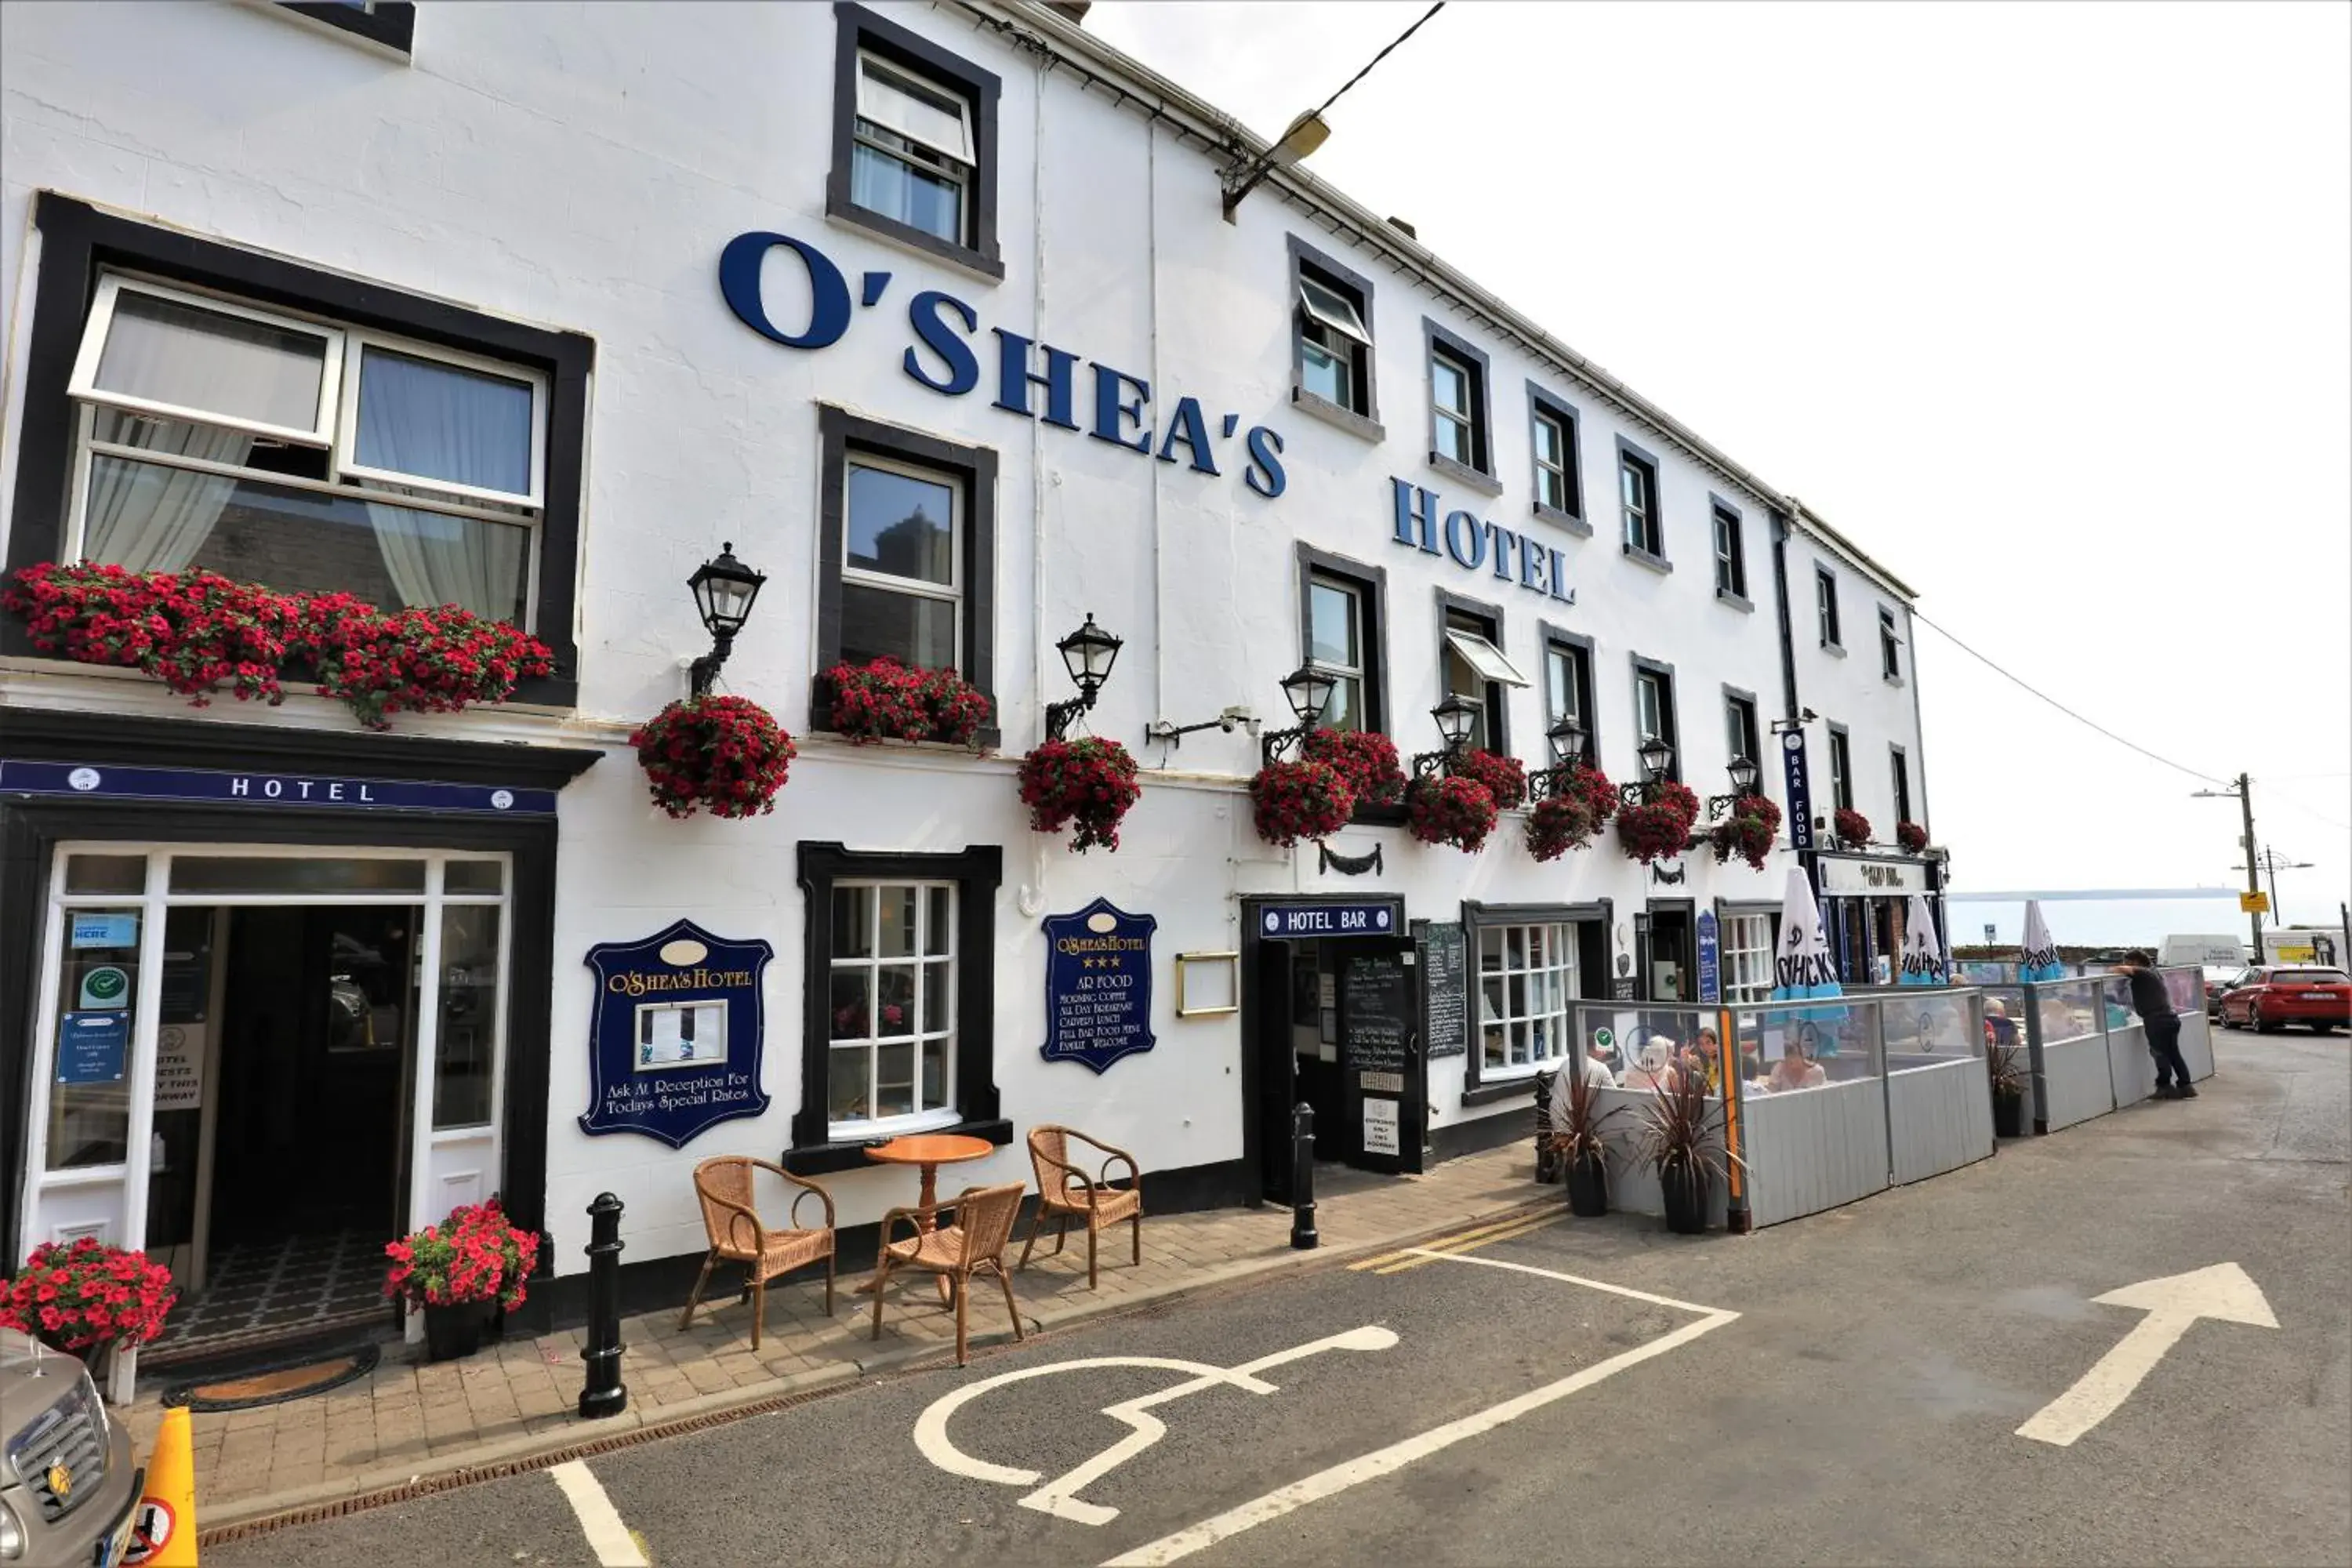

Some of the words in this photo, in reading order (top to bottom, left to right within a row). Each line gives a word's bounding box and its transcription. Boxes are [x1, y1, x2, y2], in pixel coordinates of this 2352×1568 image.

[719, 231, 1287, 498] O'SHEA'S
[1389, 475, 1576, 605] HOTEL
[1791, 755, 1802, 788] BAR
[231, 778, 375, 801] HOTEL
[1795, 800, 1807, 846] FOOD
[1288, 912, 1333, 931] HOTEL
[1341, 910, 1367, 928] BAR
[1097, 975, 1133, 989] FOOD
[655, 1076, 724, 1094] Reception
[660, 1093, 706, 1112] Special
[712, 1088, 749, 1102] Rates
